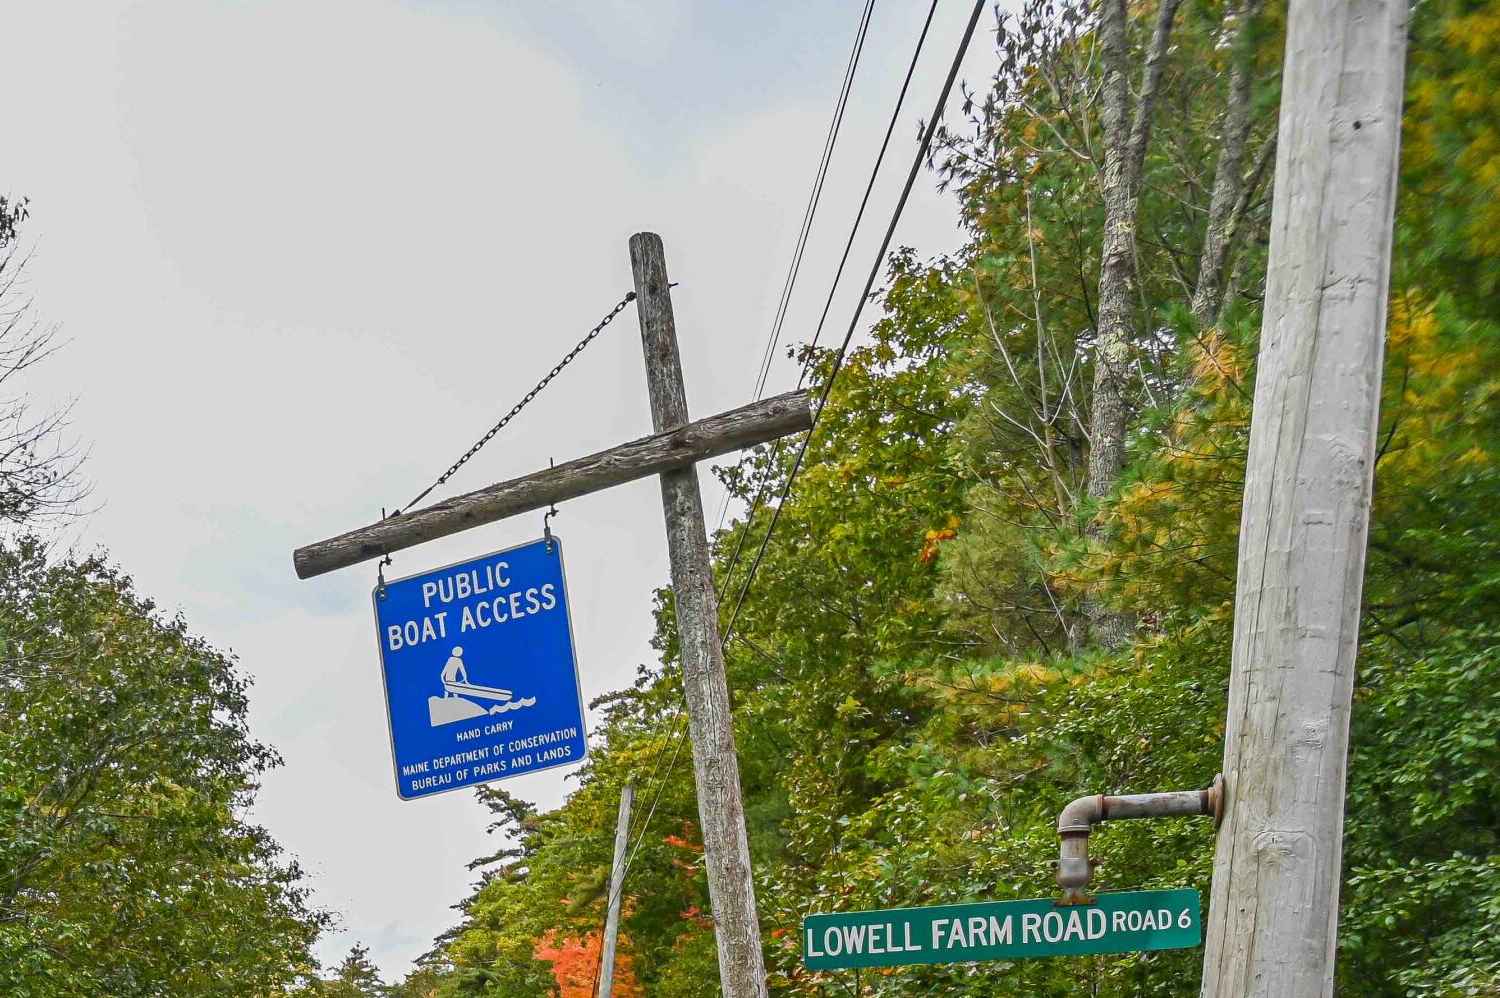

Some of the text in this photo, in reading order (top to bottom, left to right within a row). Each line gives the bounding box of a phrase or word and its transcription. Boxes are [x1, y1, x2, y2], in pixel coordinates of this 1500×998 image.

[422, 561, 511, 608] PUBLIC
[388, 583, 556, 651] BOAT ACCESS
[402, 727, 577, 776] MAINE DEPARTMENT OF CONSERVATION
[456, 720, 514, 742] HAND CARRY
[412, 745, 571, 791] BUREAU OF PARKS AND LANDS
[807, 907, 1192, 958] LOWELL FARM ROAD ROAD 6
